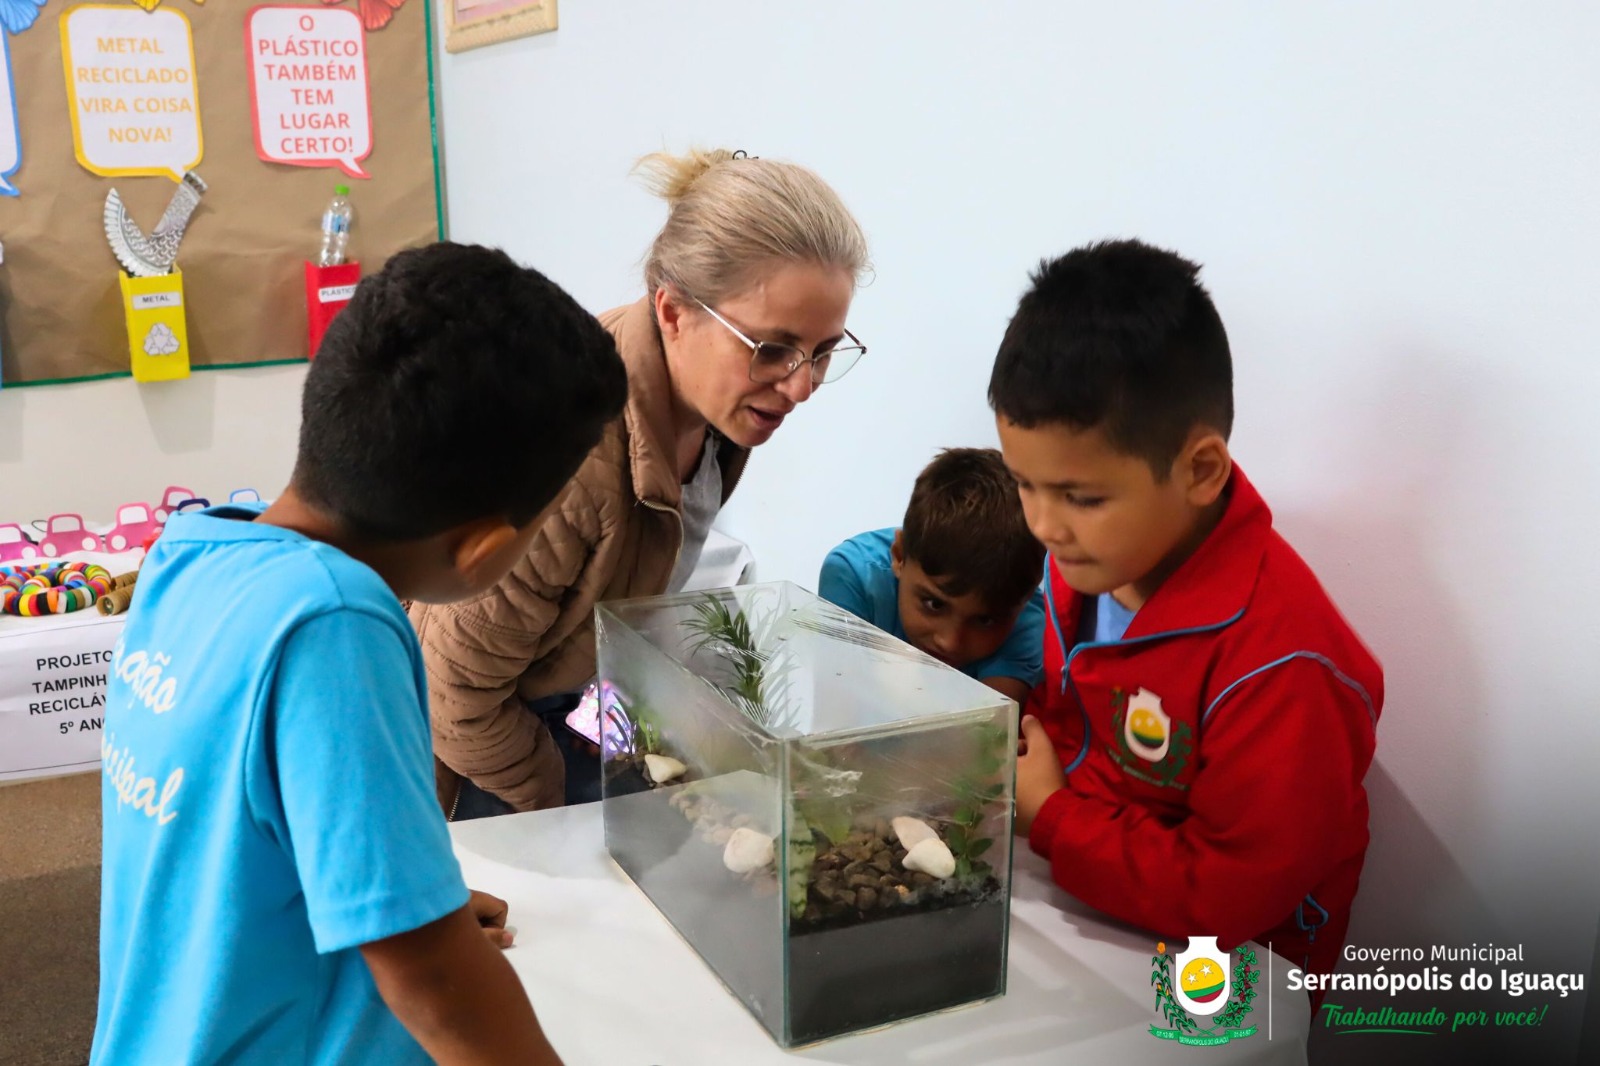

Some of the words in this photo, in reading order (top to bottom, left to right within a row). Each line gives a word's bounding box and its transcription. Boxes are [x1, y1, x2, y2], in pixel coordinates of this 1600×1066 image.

[299, 15, 315, 31] O
[97, 37, 164, 54] METAL
[258, 34, 359, 56] PLÁSTICO
[77, 67, 189, 83] RECICLADO
[264, 60, 356, 81] TAMBÉM
[80, 98, 128, 113] VIRA
[133, 97, 192, 113] COISA
[291, 89, 334, 105] TEM
[280, 113, 350, 129] LUGAR
[108, 127, 172, 143] NOVA!
[280, 136, 353, 153] CERTO!
[142, 294, 170, 303] METAL
[36, 650, 113, 671] PROJETO
[32, 674, 107, 694] TAMPINH
[29, 692, 106, 715] RECICLÁ
[60, 721, 74, 734] 5º
[79, 718, 104, 732] AN
